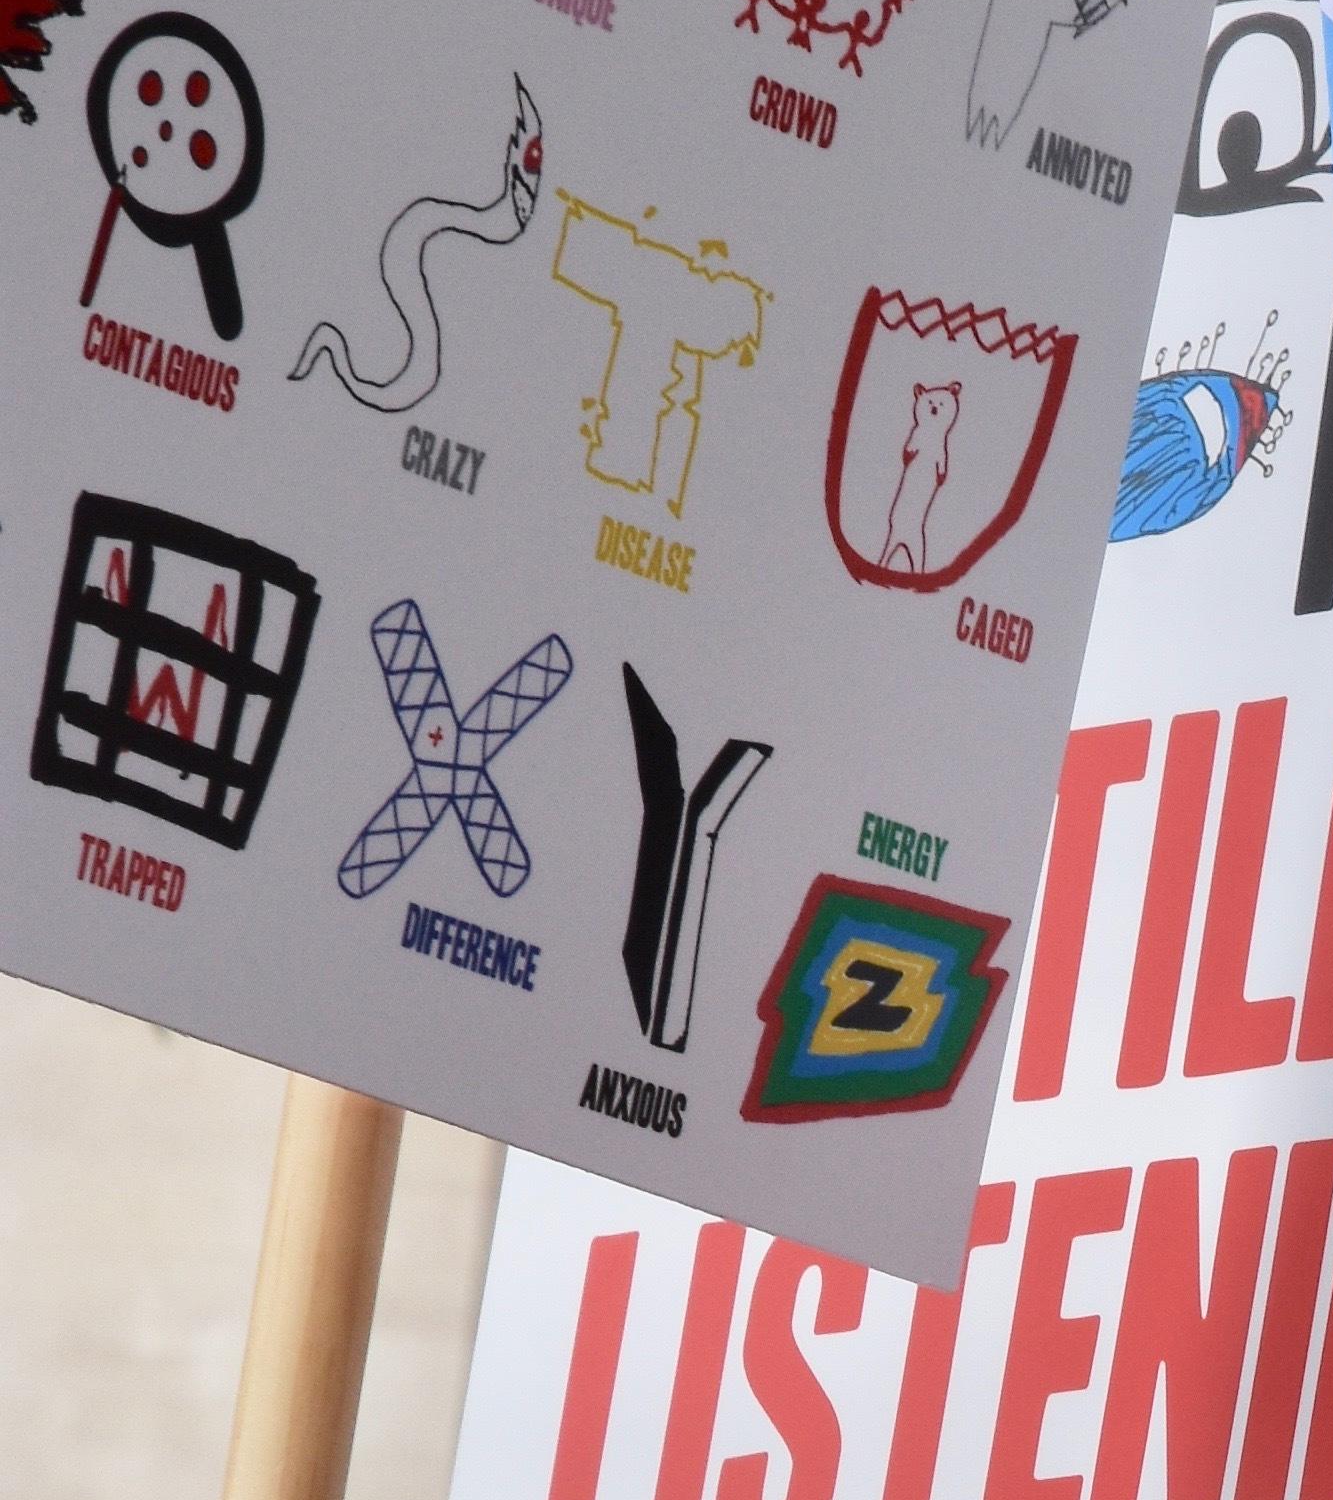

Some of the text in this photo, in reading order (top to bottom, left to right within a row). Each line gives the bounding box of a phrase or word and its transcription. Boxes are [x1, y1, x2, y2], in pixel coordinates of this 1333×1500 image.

[748, 75, 838, 150] CROWD
[1025, 127, 1133, 206] ANNOYED
[82, 312, 240, 413] CONTAGIOUS
[400, 425, 486, 495] CRAZY
[594, 515, 696, 594] DISEASE
[955, 597, 1035, 664] CAGED
[75, 832, 187, 914] TRAPPED
[856, 810, 949, 883] ENERGY
[400, 902, 541, 993] DIFFERENCE
[579, 1062, 687, 1139] ANXIOUS
